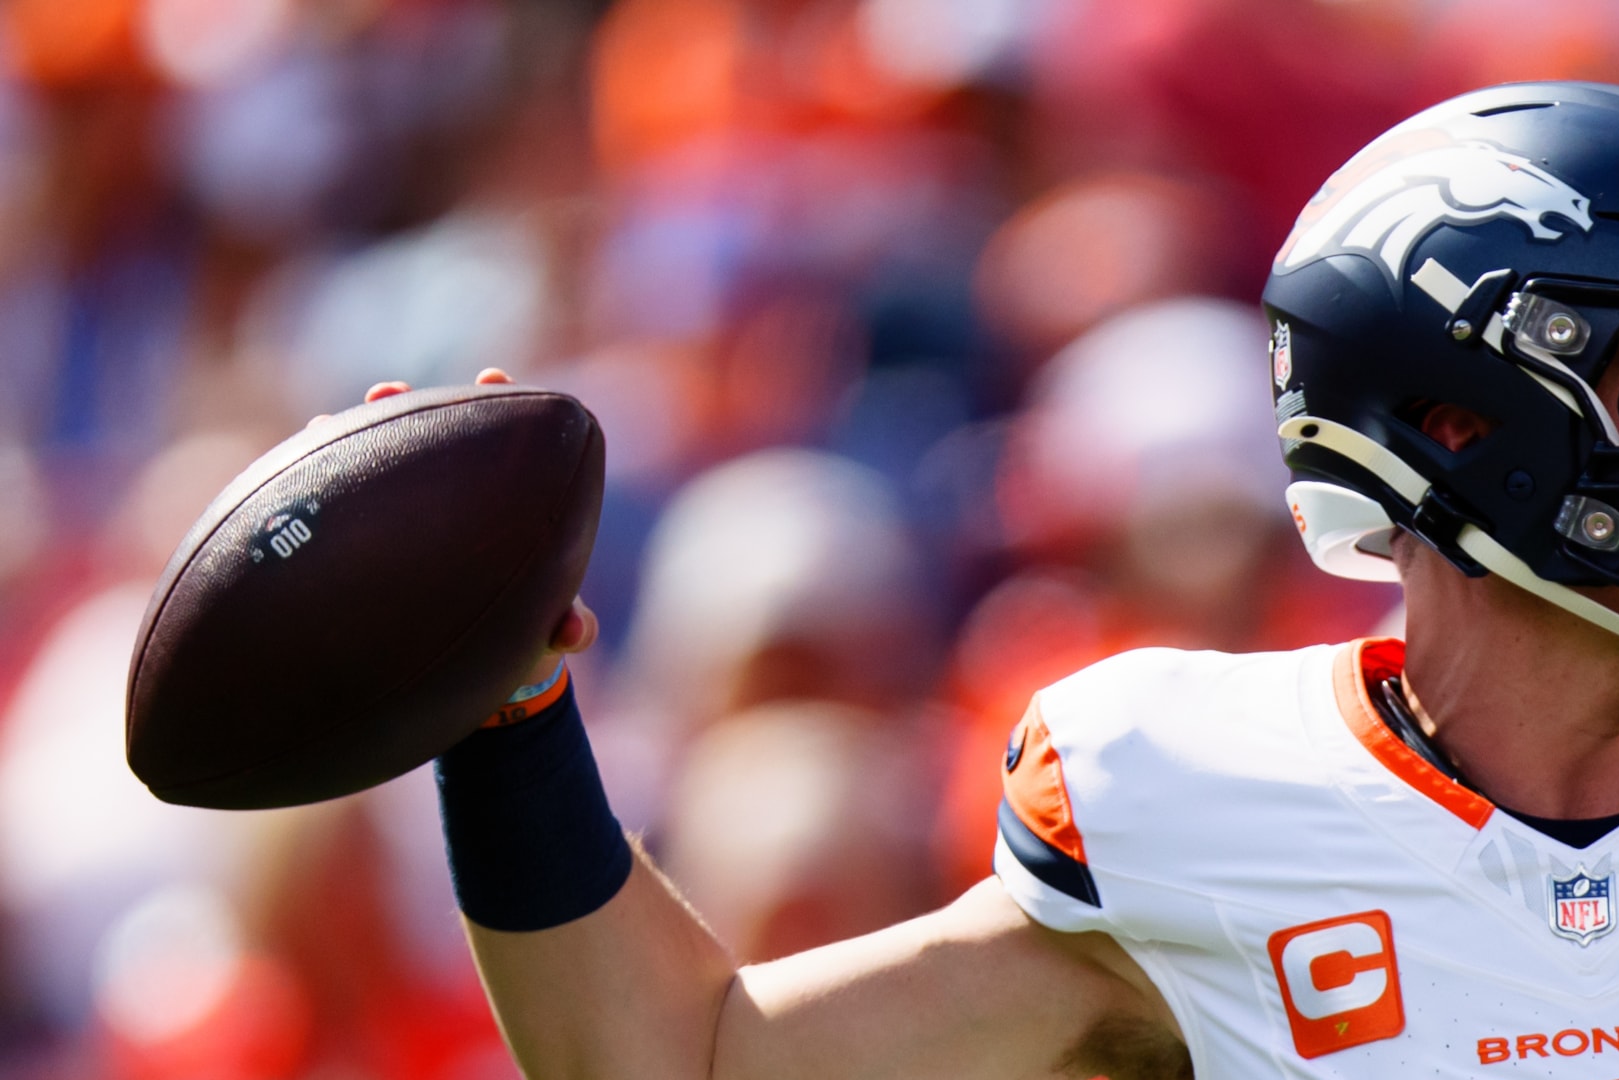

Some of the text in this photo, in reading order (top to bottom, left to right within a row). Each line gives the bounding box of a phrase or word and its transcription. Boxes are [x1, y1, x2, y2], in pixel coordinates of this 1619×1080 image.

[270, 518, 312, 558] 010
[1560, 900, 1605, 931] NFL
[1281, 921, 1389, 1021] C
